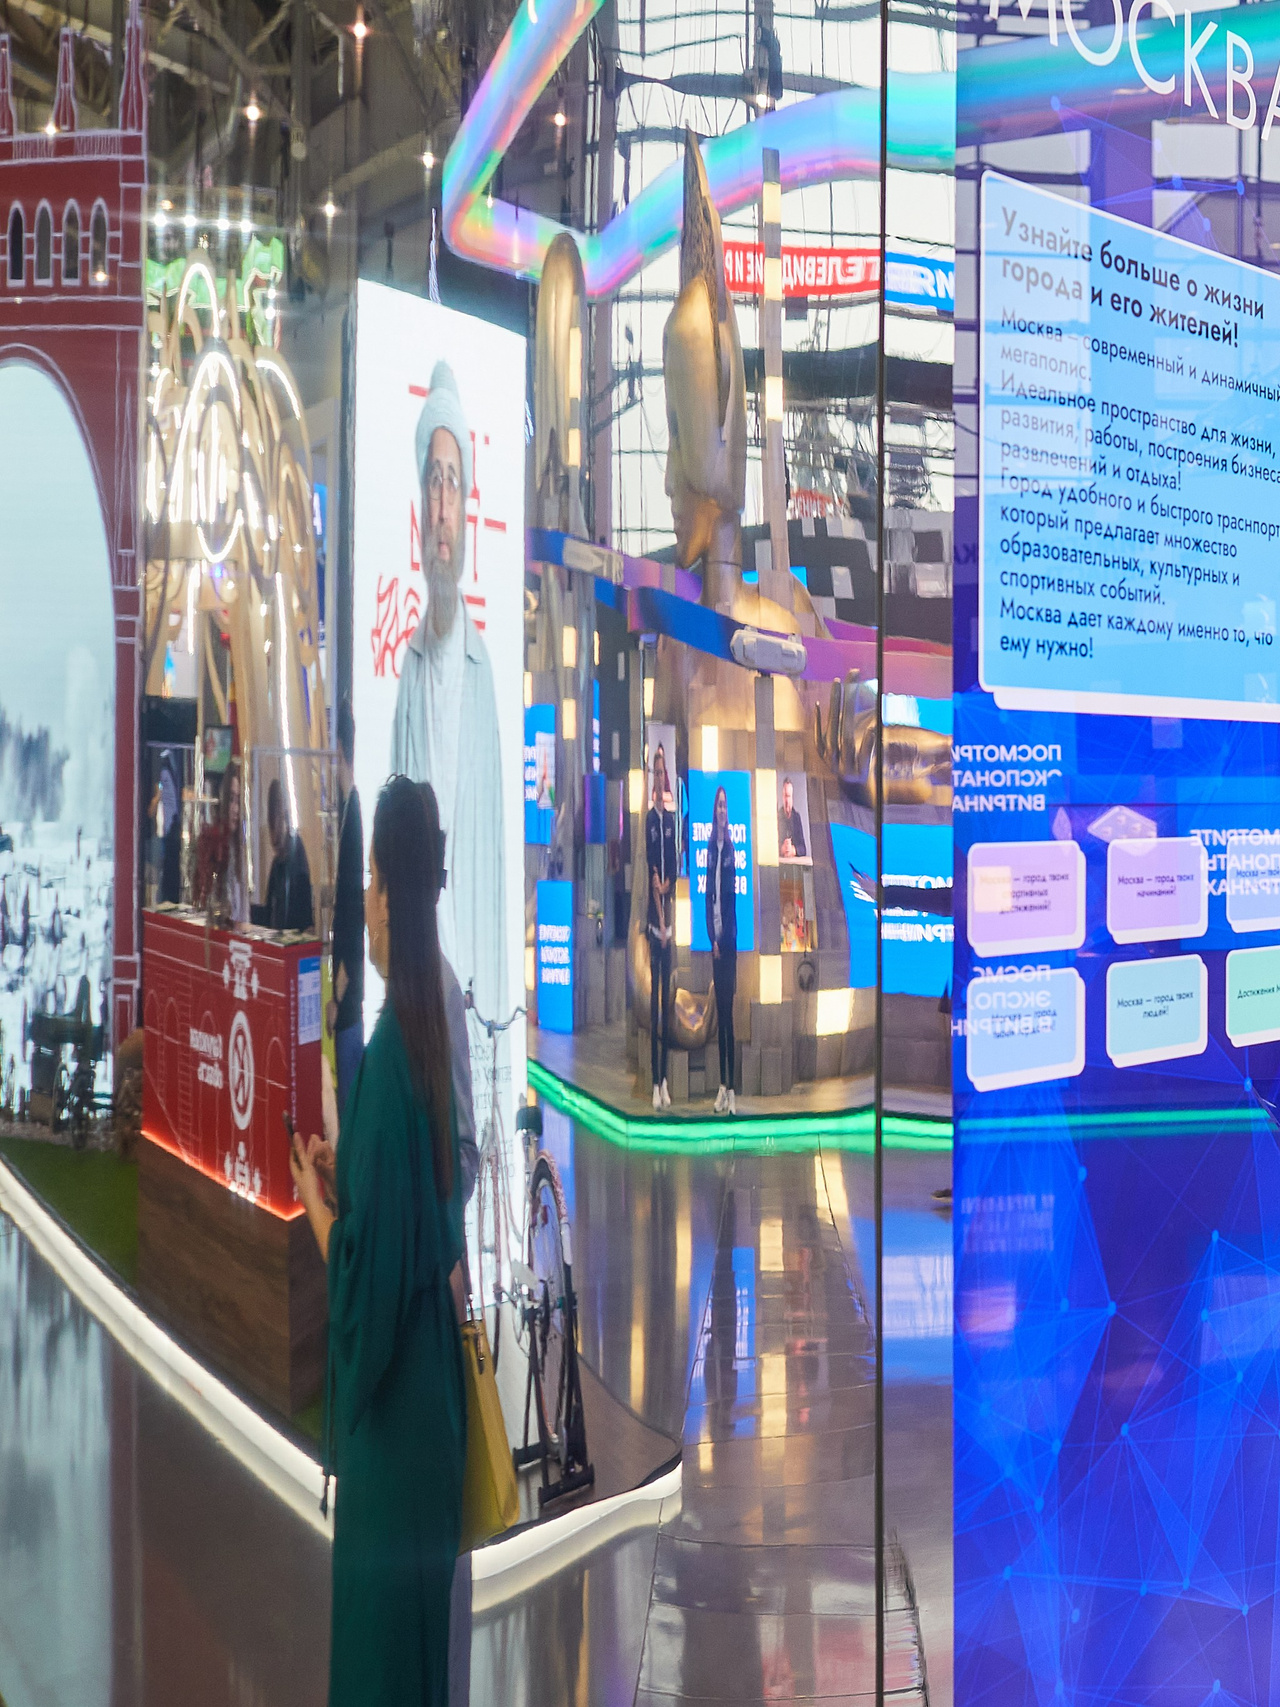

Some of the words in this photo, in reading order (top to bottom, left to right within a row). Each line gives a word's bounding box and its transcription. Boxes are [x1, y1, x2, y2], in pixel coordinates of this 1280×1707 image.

[1001, 206, 1093, 263] Узнайте
[1100, 240, 1180, 292] больше
[1187, 278, 1198, 296] о
[1204, 283, 1265, 320] жизни
[1001, 258, 1083, 301] города
[1091, 286, 1103, 306] и
[1111, 291, 1142, 319] его
[1149, 300, 1239, 348] жителей!
[1001, 308, 1063, 342] Москва
[1083, 337, 1184, 378] современный
[1189, 361, 1197, 378] и
[1001, 348, 1092, 383] мегаполис.
[1001, 371, 1096, 414] Идеальное
[1101, 400, 1196, 436] пространство
[1201, 424, 1227, 444] для
[1231, 432, 1276, 459] жизни,
[1001, 406, 1080, 443] развития,
[1084, 427, 1143, 455] работы,
[1148, 442, 1228, 474] построения
[1001, 441, 1107, 478] развлечений
[1112, 464, 1121, 479] и
[1126, 467, 1182, 492] отдыха!
[1001, 467, 1053, 498] Город
[1058, 484, 1132, 512] удобного
[1137, 498, 1146, 513] и
[1150, 496, 1213, 527] быстрого
[1000, 505, 1068, 531] который
[1075, 518, 1160, 547] предлагает
[1164, 534, 1237, 559] множество
[1000, 536, 1145, 576] образовательных,
[1150, 560, 1229, 586] культурных
[1232, 573, 1240, 587] и
[1000, 570, 1095, 598] спортивных
[1100, 582, 1166, 606] событий.
[1000, 600, 1062, 624] Москва
[1067, 608, 1102, 628] дает
[1107, 615, 1173, 638] каждому
[1178, 622, 1229, 642] именно
[1233, 628, 1250, 648] то,
[1254, 631, 1273, 646] что
[1000, 636, 1030, 660] ему
[1036, 637, 1094, 661] нужно!
